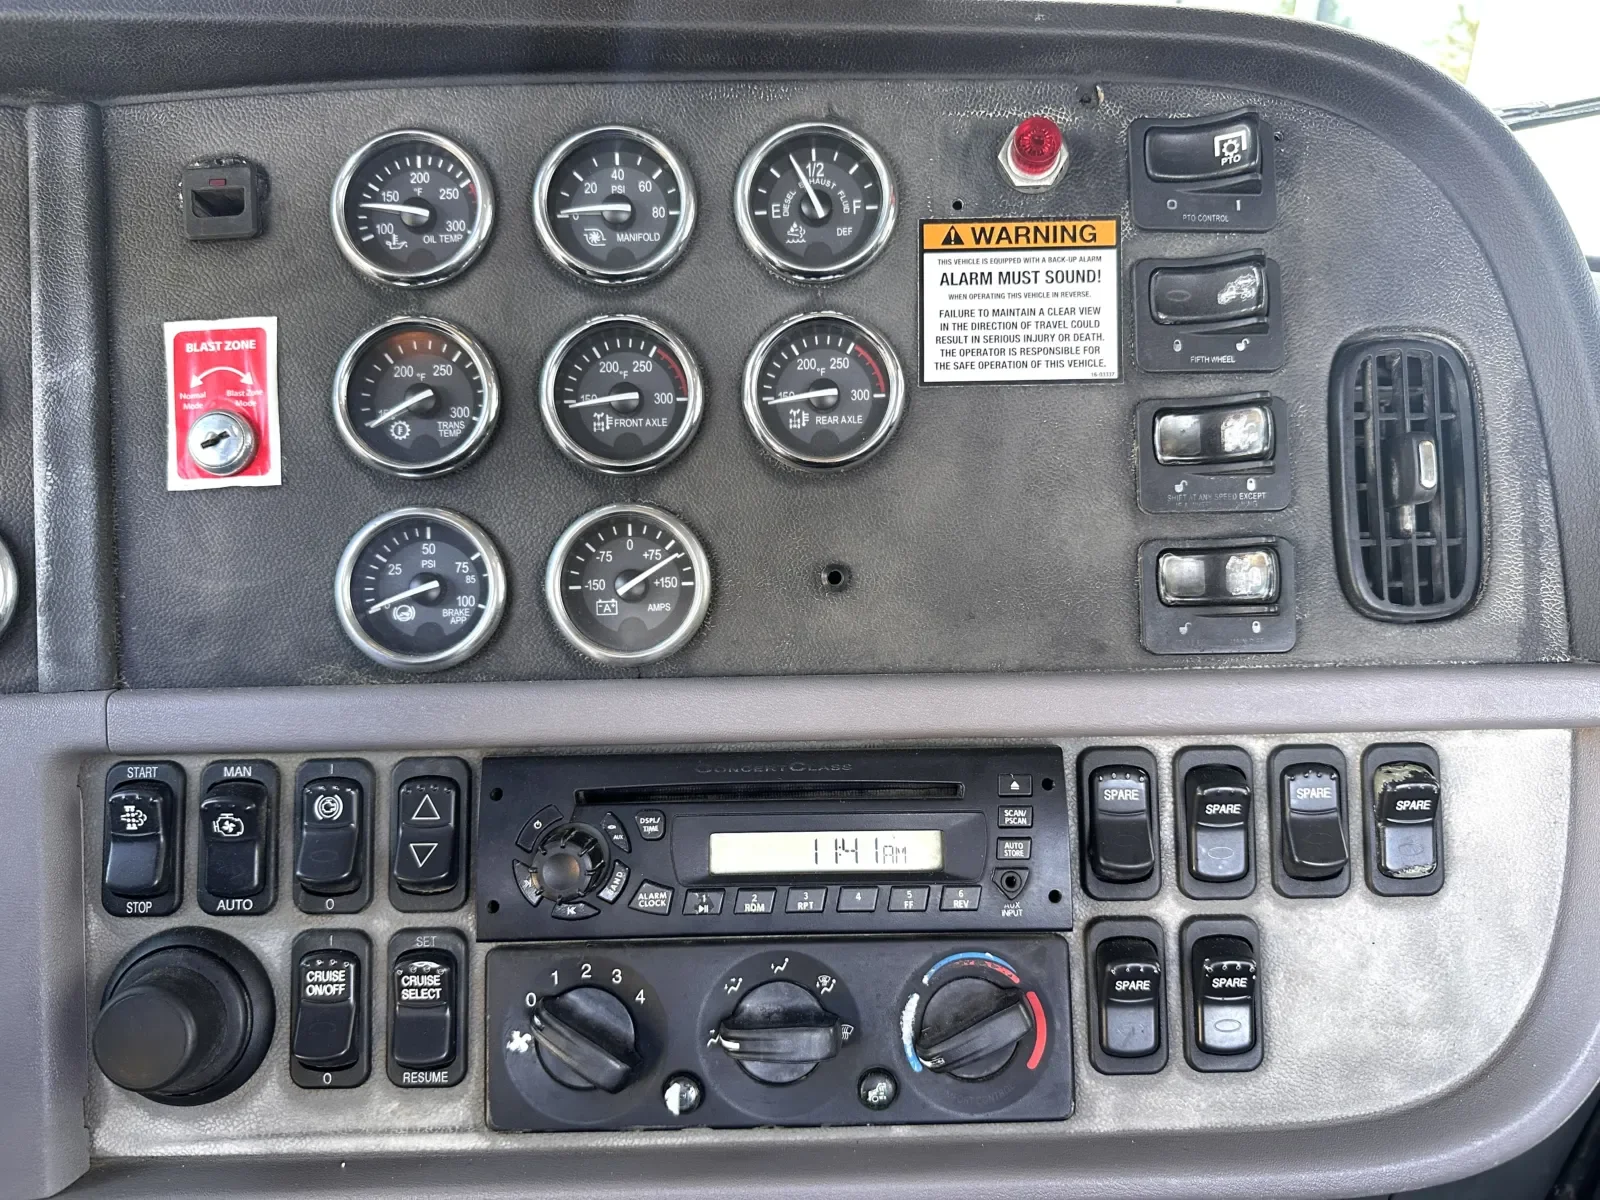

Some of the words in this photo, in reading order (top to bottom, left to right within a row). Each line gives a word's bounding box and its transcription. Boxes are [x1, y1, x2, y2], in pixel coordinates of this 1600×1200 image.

[1221, 154, 1242, 166] PTO
[611, 169, 624, 180] 40
[806, 162, 824, 177] 1/2
[410, 172, 430, 183] 200
[584, 182, 597, 194] 20
[611, 185, 625, 194] PSI
[638, 181, 652, 192] 60
[382, 191, 399, 202] 150
[440, 188, 459, 199] 250
[783, 190, 796, 217] DIESEL
[837, 190, 850, 214] FLUID
[853, 200, 861, 214] F
[652, 207, 665, 218] 80
[772, 204, 781, 218] E
[1182, 214, 1197, 222] PTO
[1197, 214, 1229, 222] CONTROL
[376, 223, 394, 234] 100
[446, 220, 465, 231] 300
[837, 227, 853, 236] DEF
[971, 224, 1097, 245] WARNING
[423, 235, 437, 244] OIL
[439, 234, 463, 242] TEMP
[616, 233, 660, 242] MANIFOLD
[990, 257, 1021, 265] EQUIPPED
[940, 272, 992, 286] ALARM
[998, 270, 1040, 285] MUST
[1045, 269, 1101, 284] SOUND!
[939, 309, 975, 318] FAILURE
[978, 308, 989, 317] TO
[992, 307, 1036, 317] MAINTAIN
[1038, 307, 1045, 316] A
[1047, 307, 1076, 316] CLEAR
[1079, 306, 1101, 315] VIEW
[940, 322, 949, 331] IN
[952, 322, 968, 331] THE
[971, 321, 1018, 331] DIRECTION
[1020, 321, 1032, 329] OF
[1034, 320, 1068, 329] TRAVEL
[1071, 320, 1100, 328] COULD
[936, 335, 968, 344] RESULT
[971, 335, 980, 344] IN
[983, 334, 1021, 343] SERIOUS
[1024, 333, 1055, 342] INJURY
[1058, 333, 1070, 342] OR
[1073, 333, 1105, 341] DEATH.
[185, 341, 222, 353] BLAST
[224, 339, 257, 351] ZONE
[940, 348, 957, 357] THE
[959, 348, 1006, 357] OPERATOR
[1008, 347, 1017, 356] IS
[1020, 346, 1080, 356] RESPONSIBLE
[1083, 346, 1100, 355] FOR
[797, 359, 817, 370] 200
[830, 358, 850, 369] 250
[934, 361, 951, 370] THE
[953, 361, 975, 370] SAFE
[978, 360, 1028, 370] OPERATION
[1030, 360, 1042, 369] OF
[1045, 359, 1065, 368] THIS
[1067, 359, 1106, 368] VEHICLE.
[1211, 356, 1236, 364] WHEEL
[393, 366, 414, 378] 200
[433, 365, 452, 376] 250
[600, 361, 619, 373] 200
[632, 361, 653, 372] 250
[179, 391, 206, 400] Normal
[226, 389, 245, 397] Blast
[246, 389, 264, 397] Zone
[654, 393, 674, 404] 300
[850, 389, 870, 401] 300
[183, 402, 204, 410] Mode
[450, 407, 470, 418] 300
[437, 421, 466, 429] TRANS
[614, 418, 643, 428] FRONT
[645, 418, 668, 427] AXLE
[816, 416, 839, 425] REAR
[841, 415, 863, 424] AXLE
[438, 429, 462, 437] TEMP
[1239, 492, 1267, 500] EXCEPT
[422, 544, 436, 555] 50
[626, 539, 634, 550] 0
[596, 551, 613, 562] -75
[642, 549, 662, 561] +75
[388, 564, 402, 575] 25
[421, 560, 436, 568] PSI
[455, 562, 469, 573] 75
[465, 575, 476, 583] 85
[585, 579, 606, 590] -150
[654, 577, 678, 588] +150
[456, 596, 476, 607] 100
[442, 609, 470, 617] BRAKE
[647, 603, 671, 612] AMPS
[127, 767, 159, 778] START
[223, 766, 252, 777] MAN
[1104, 789, 1139, 801] SPARE
[1296, 787, 1333, 799] SPARE
[1205, 804, 1242, 814] SPARE
[1396, 800, 1432, 811] SPARE
[1004, 817, 1027, 825] PSCAN
[643, 825, 659, 833] TIME
[814, 837, 879, 864] 11:41
[883, 845, 907, 864] AM
[1004, 849, 1024, 857] STORE
[637, 892, 668, 900] ALARM
[752, 894, 758, 902] 2
[803, 892, 809, 900] 3
[855, 892, 862, 901] 4
[906, 890, 913, 898] 5
[958, 890, 964, 898] 6
[126, 902, 153, 913] STOP
[216, 899, 254, 911] AUTO
[744, 903, 765, 912] RDM
[797, 902, 814, 910] RPT
[904, 901, 914, 909] FF
[953, 900, 969, 908] REV
[1001, 909, 1023, 917] INPUT
[416, 936, 437, 947] SET
[581, 963, 592, 978] 2
[612, 968, 623, 984] 3
[306, 970, 346, 983] CRUISE
[401, 974, 442, 987] CRUISE
[551, 970, 559, 986] 1
[1115, 980, 1151, 991] SPARE
[1212, 977, 1248, 989] SPARE
[306, 983, 346, 997] ON/OFF
[401, 988, 442, 1000] SELECT
[525, 992, 537, 1007] 0
[635, 989, 646, 1004] 4
[402, 1071, 449, 1083] RESUME
